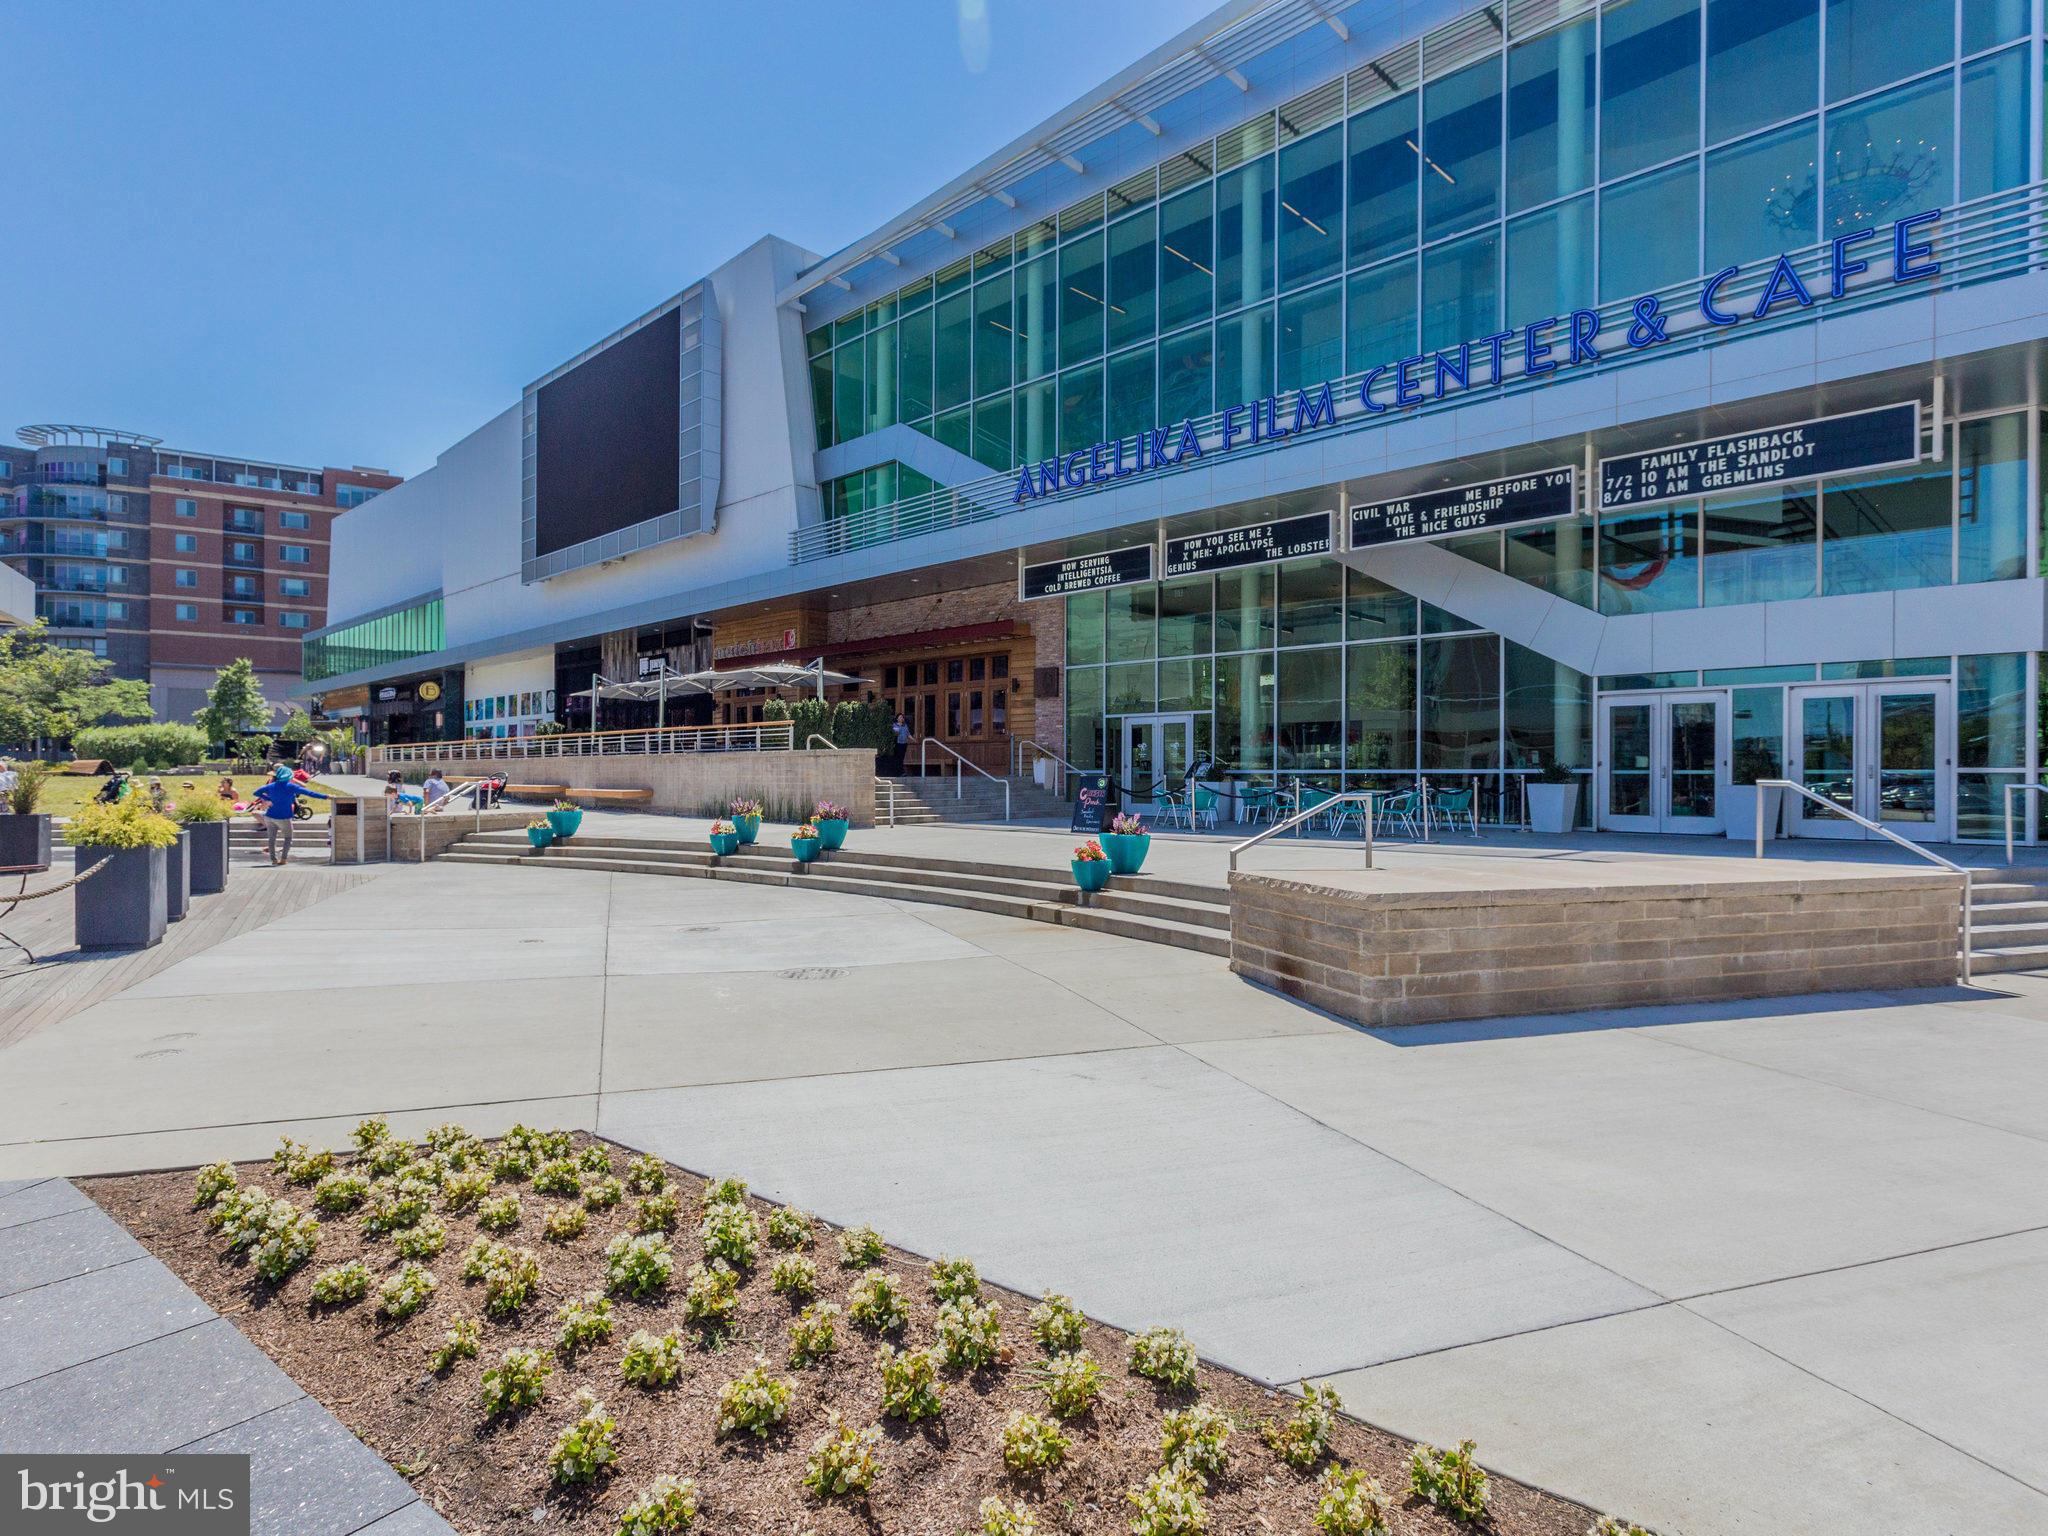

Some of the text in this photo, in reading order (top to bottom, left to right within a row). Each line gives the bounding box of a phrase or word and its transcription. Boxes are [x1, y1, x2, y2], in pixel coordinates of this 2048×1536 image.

[1013, 209, 1941, 502] ANGELIKA FILM CENTER & CAFE
[1641, 429, 1804, 470] FAMILY FLASHBACK
[1606, 474, 1632, 490] 7/2
[1666, 466, 1689, 480] AM
[1698, 459, 1727, 474] THE
[1737, 442, 1816, 467] SANDLOT
[1465, 487, 1482, 501] ME
[1488, 478, 1537, 497] BEFORE
[1603, 486, 1632, 504] 8/6
[1666, 479, 1689, 494] AM
[1702, 463, 1785, 488] GREMLINS
[1353, 502, 1410, 521] CIVIL WAR
[1385, 498, 1504, 528] LOVE & FRIENDSHIP
[1395, 513, 1486, 538] THE NICE GUYS
[1183, 537, 1274, 561] X MEN: APOCALYPSE
[1184, 526, 1273, 551] NOW YOU SEE ME 2
[1062, 555, 1110, 572] NOW SERVING
[1265, 548, 1283, 558] THE
[1057, 565, 1113, 582] INTELLIGENTSIA
[1167, 561, 1197, 574] GENIUS
[1044, 573, 1121, 593] COLD BREWED COFFEE
